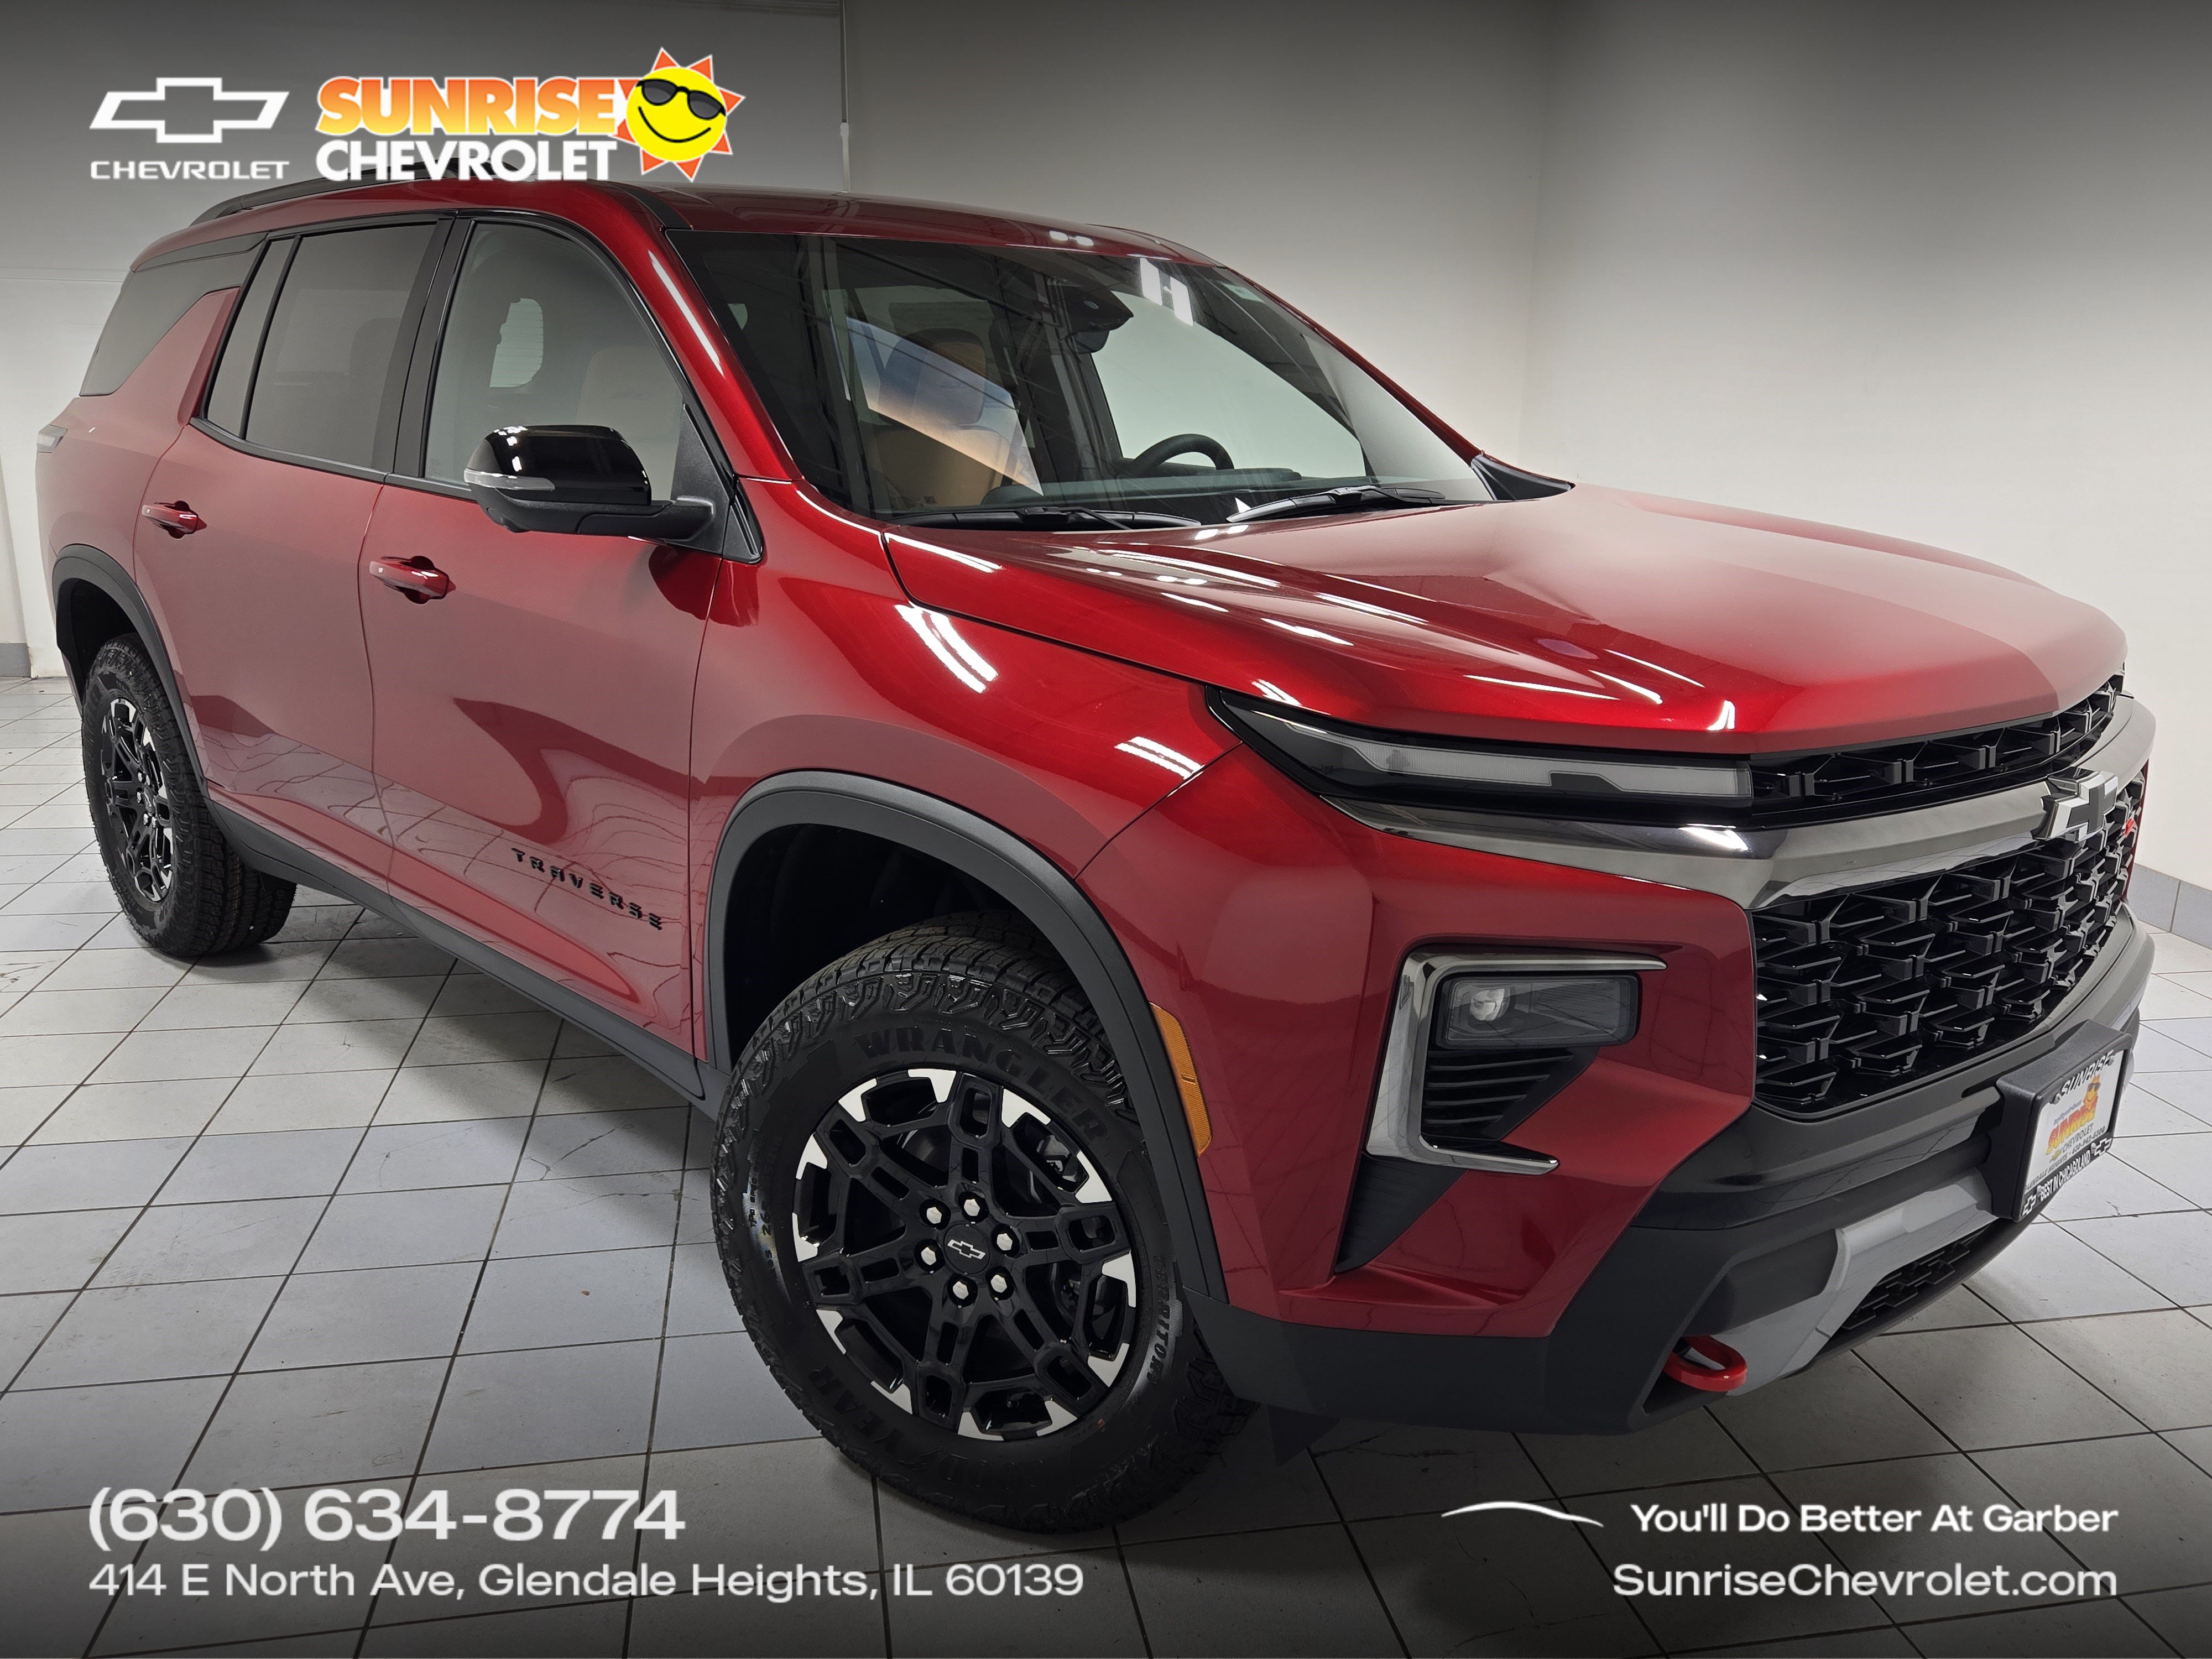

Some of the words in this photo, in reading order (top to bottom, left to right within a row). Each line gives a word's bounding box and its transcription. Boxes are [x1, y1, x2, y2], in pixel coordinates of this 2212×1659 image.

[511, 847, 663, 930] TRAVERSE
[854, 1025, 1108, 1139] WRANGLER
[2060, 1050, 2114, 1097] SUNRISE
[2059, 1150, 2091, 1187] CHICAGOLAND
